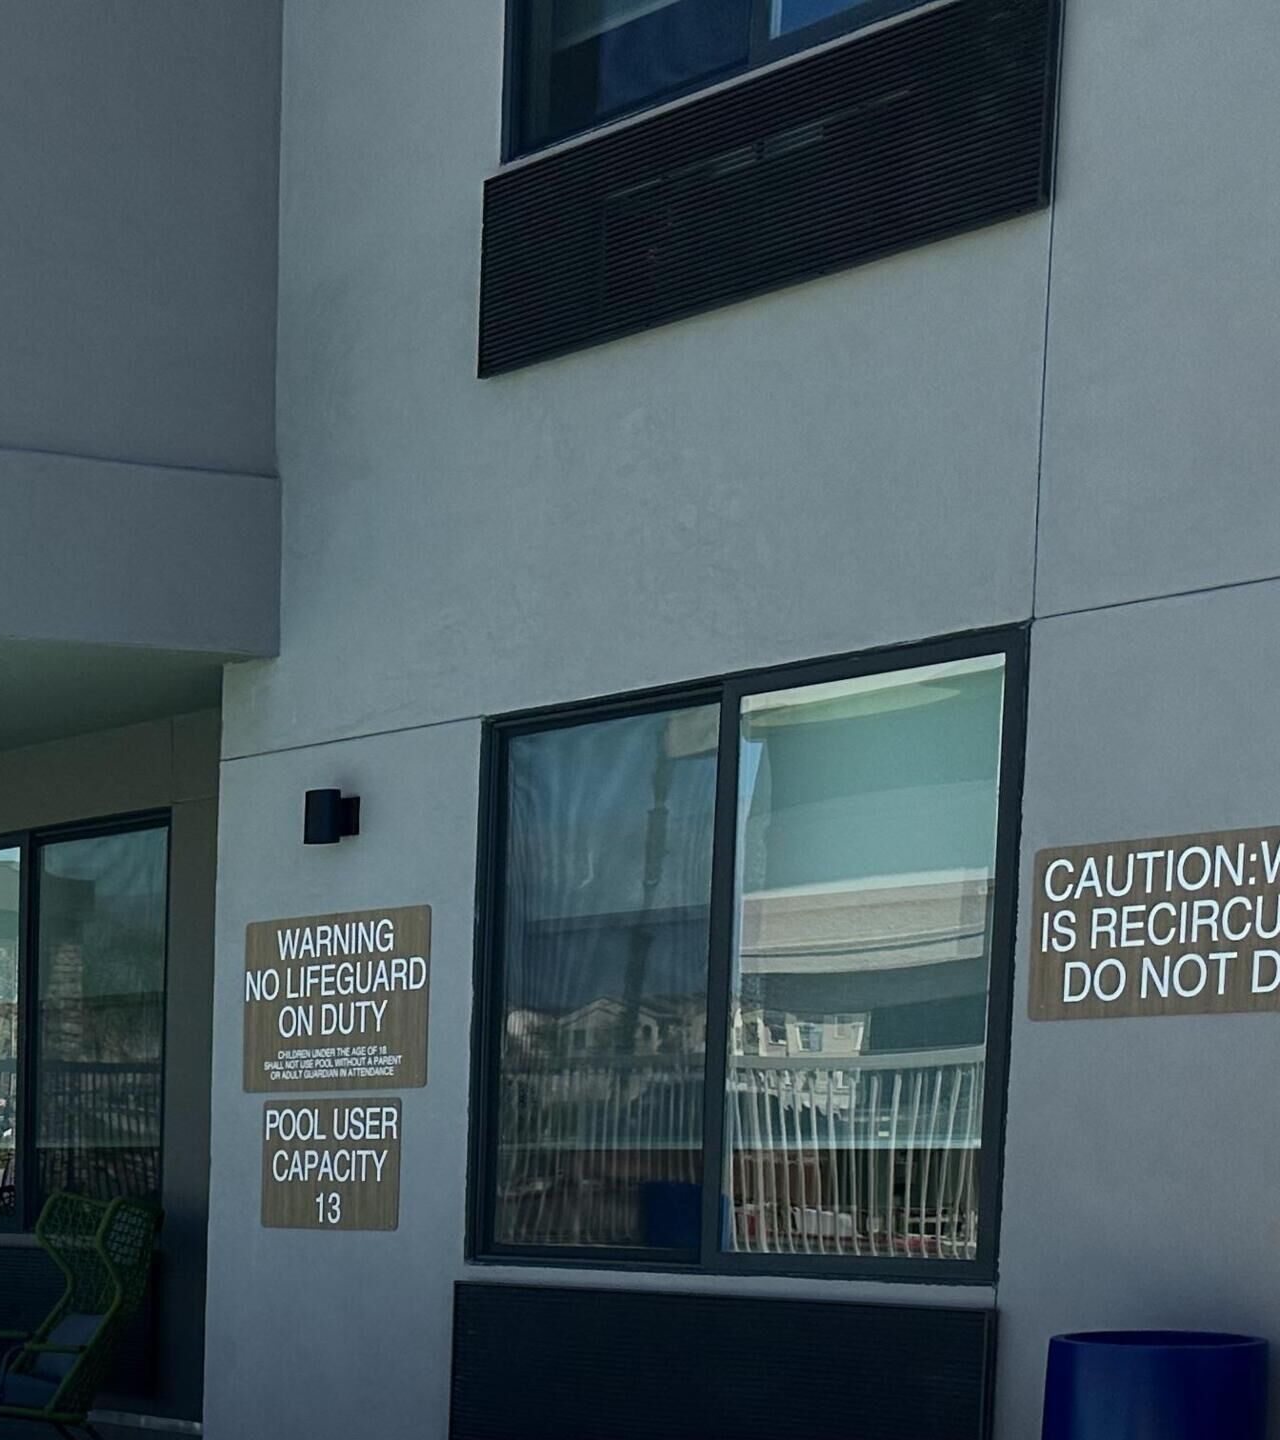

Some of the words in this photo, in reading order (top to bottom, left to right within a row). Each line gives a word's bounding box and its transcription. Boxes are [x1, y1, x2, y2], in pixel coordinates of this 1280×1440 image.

[277, 918, 394, 961] WARNING
[1041, 910, 1077, 952] IS
[1090, 895, 1280, 950] RECIRCU
[245, 968, 280, 1002] NO
[286, 956, 427, 999] LIFEGUARD
[1063, 958, 1127, 1002] DO
[1140, 951, 1238, 998] NOT
[278, 1005, 314, 1038] ON
[320, 999, 388, 1036] DUTY
[263, 1061, 285, 1071] SHALL
[285, 1060, 300, 1070] NOT
[300, 1059, 314, 1069] USE
[314, 1058, 334, 1068] POOL
[334, 1056, 367, 1067] WITHOUT
[366, 1056, 373, 1066] A
[373, 1055, 403, 1066] PARENT
[278, 1049, 311, 1060] CHILDREN
[311, 1047, 336, 1058] UNDER
[336, 1047, 351, 1057] THE
[351, 1045, 367, 1056] AGE
[367, 1045, 378, 1056] OF
[270, 1070, 281, 1080] OR
[281, 1069, 303, 1080] ADULT
[303, 1068, 339, 1079] GUARDIAN
[339, 1067, 347, 1078] IN
[347, 1066, 395, 1077] ATTENDANCE
[265, 1108, 327, 1141] POOL
[333, 1106, 398, 1141] USER
[272, 1149, 389, 1182] CAPACITY
[315, 1192, 341, 1224] 13
